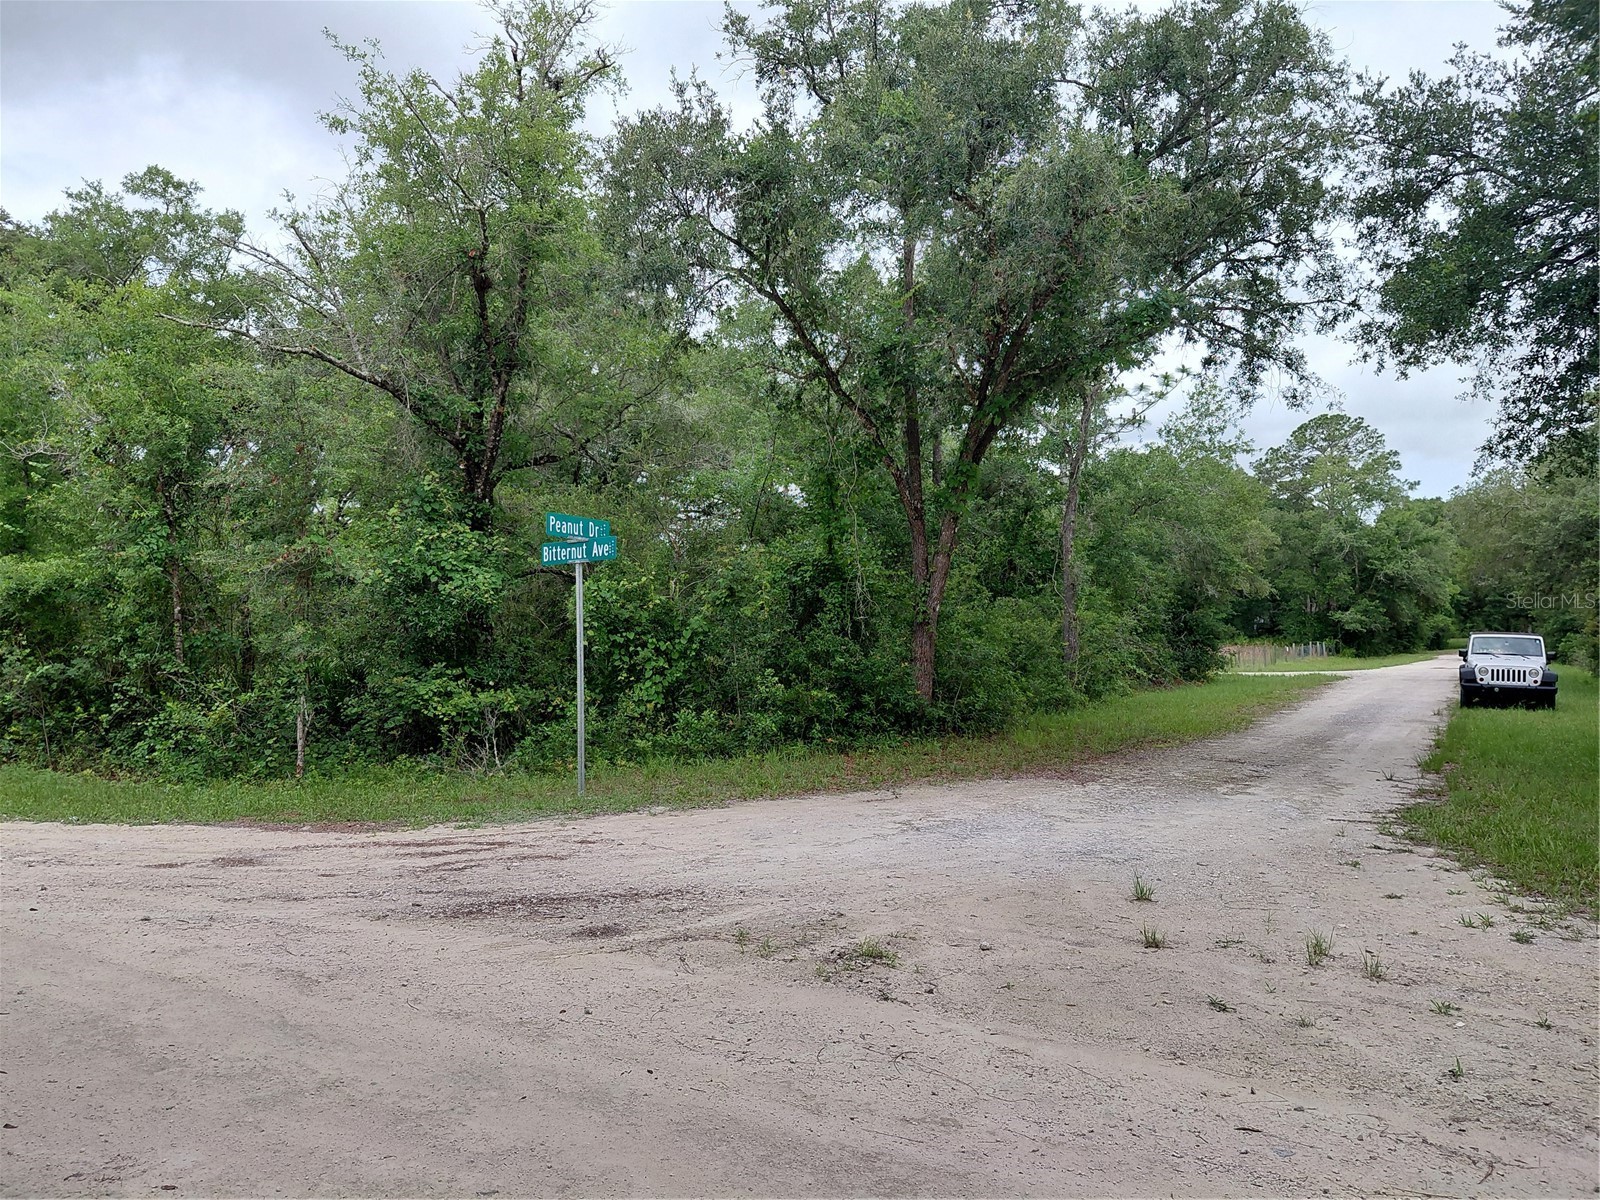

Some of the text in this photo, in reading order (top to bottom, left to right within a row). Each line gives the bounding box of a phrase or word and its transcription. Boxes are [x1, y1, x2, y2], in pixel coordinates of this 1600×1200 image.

[549, 516, 583, 536] Peanut
[589, 522, 599, 537] Dr
[543, 543, 587, 562] Bitternut
[592, 541, 609, 557] Ave
